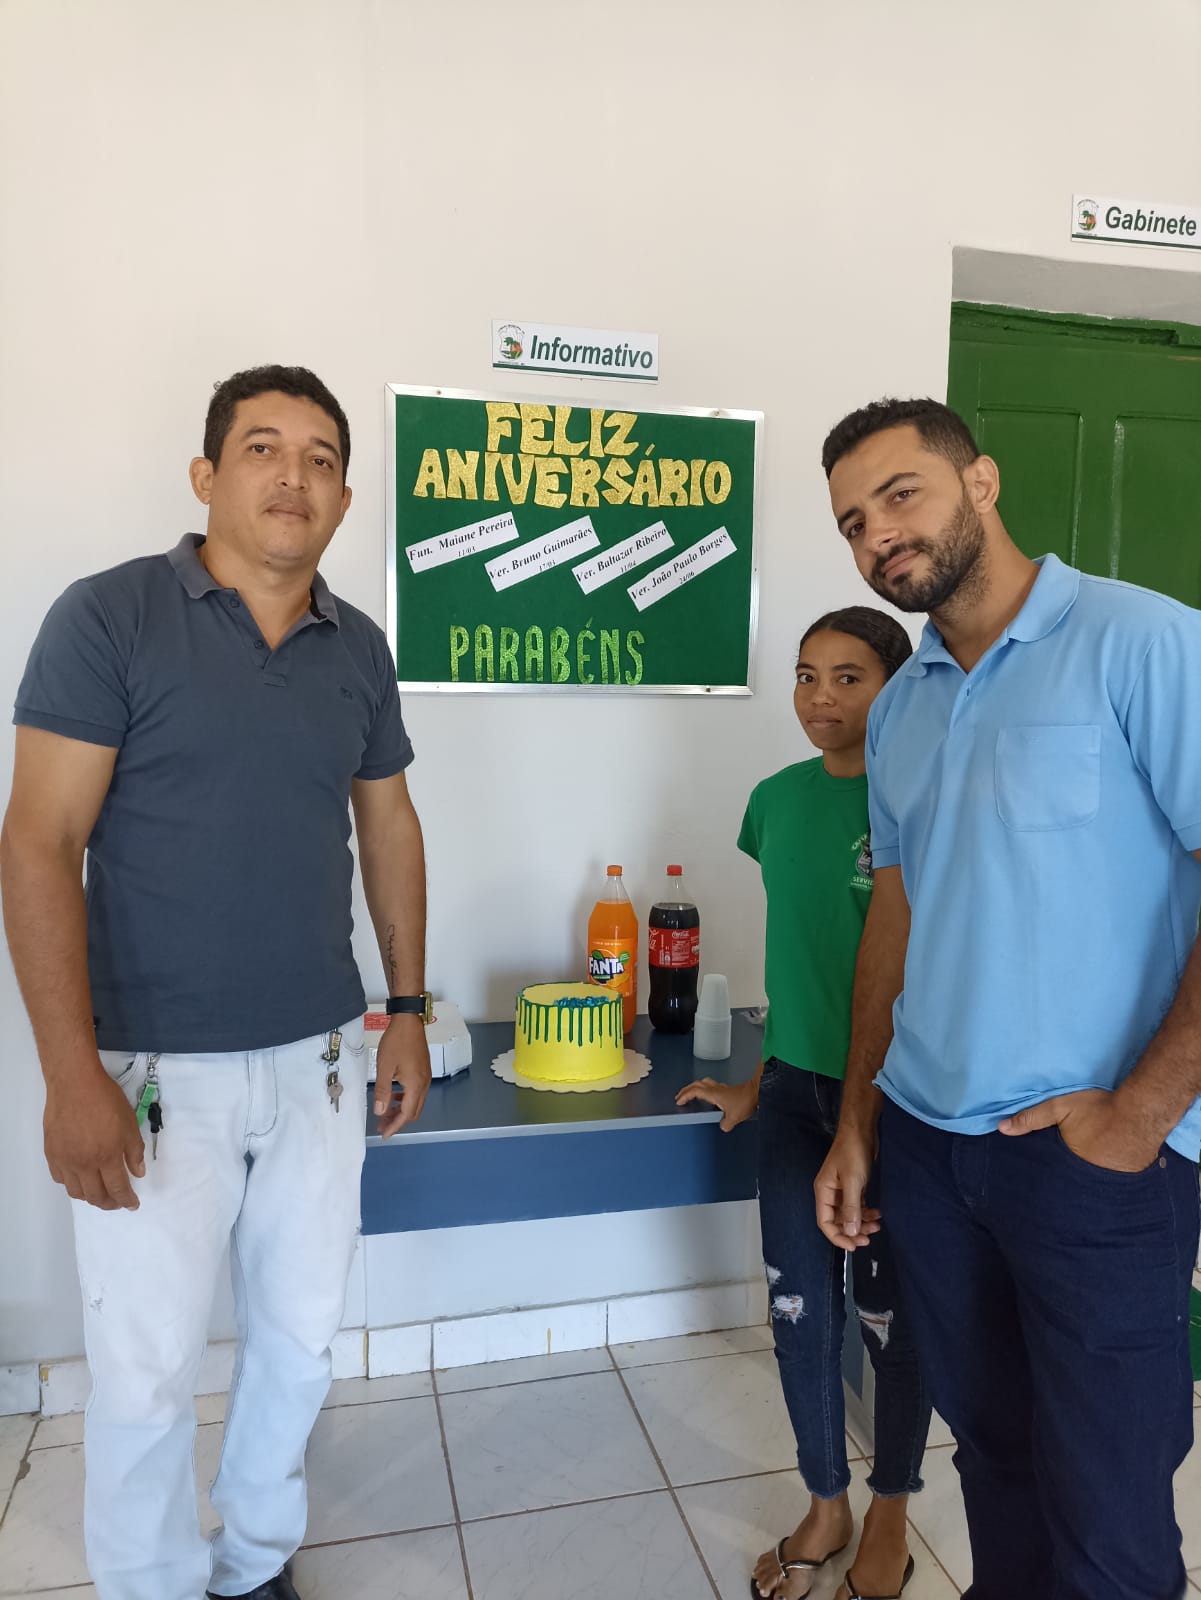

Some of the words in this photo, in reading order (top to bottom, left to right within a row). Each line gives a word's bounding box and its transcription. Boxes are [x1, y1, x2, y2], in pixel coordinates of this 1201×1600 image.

[1105, 205, 1197, 236] Gabinete
[530, 334, 654, 370] Informativo
[485, 401, 640, 458] FELIZ
[413, 442, 732, 508] ANIVERSÁRIO
[409, 546, 433, 561] Fun.
[438, 530, 476, 551] Maiane
[478, 517, 514, 537] Pereira
[489, 565, 510, 580] Ver.
[511, 551, 541, 571] Bruno
[543, 526, 593, 555] Guimarães
[576, 568, 596, 583] Ver.
[597, 545, 633, 572] Baltazar
[635, 527, 667, 551] Ribeiro
[631, 585, 650, 600] Ver.
[652, 570, 672, 588] João
[672, 552, 698, 573] Paulo
[698, 532, 728, 556] Borges
[449, 616, 646, 686] PARABÉNS
[588, 956, 625, 975] FANTA
